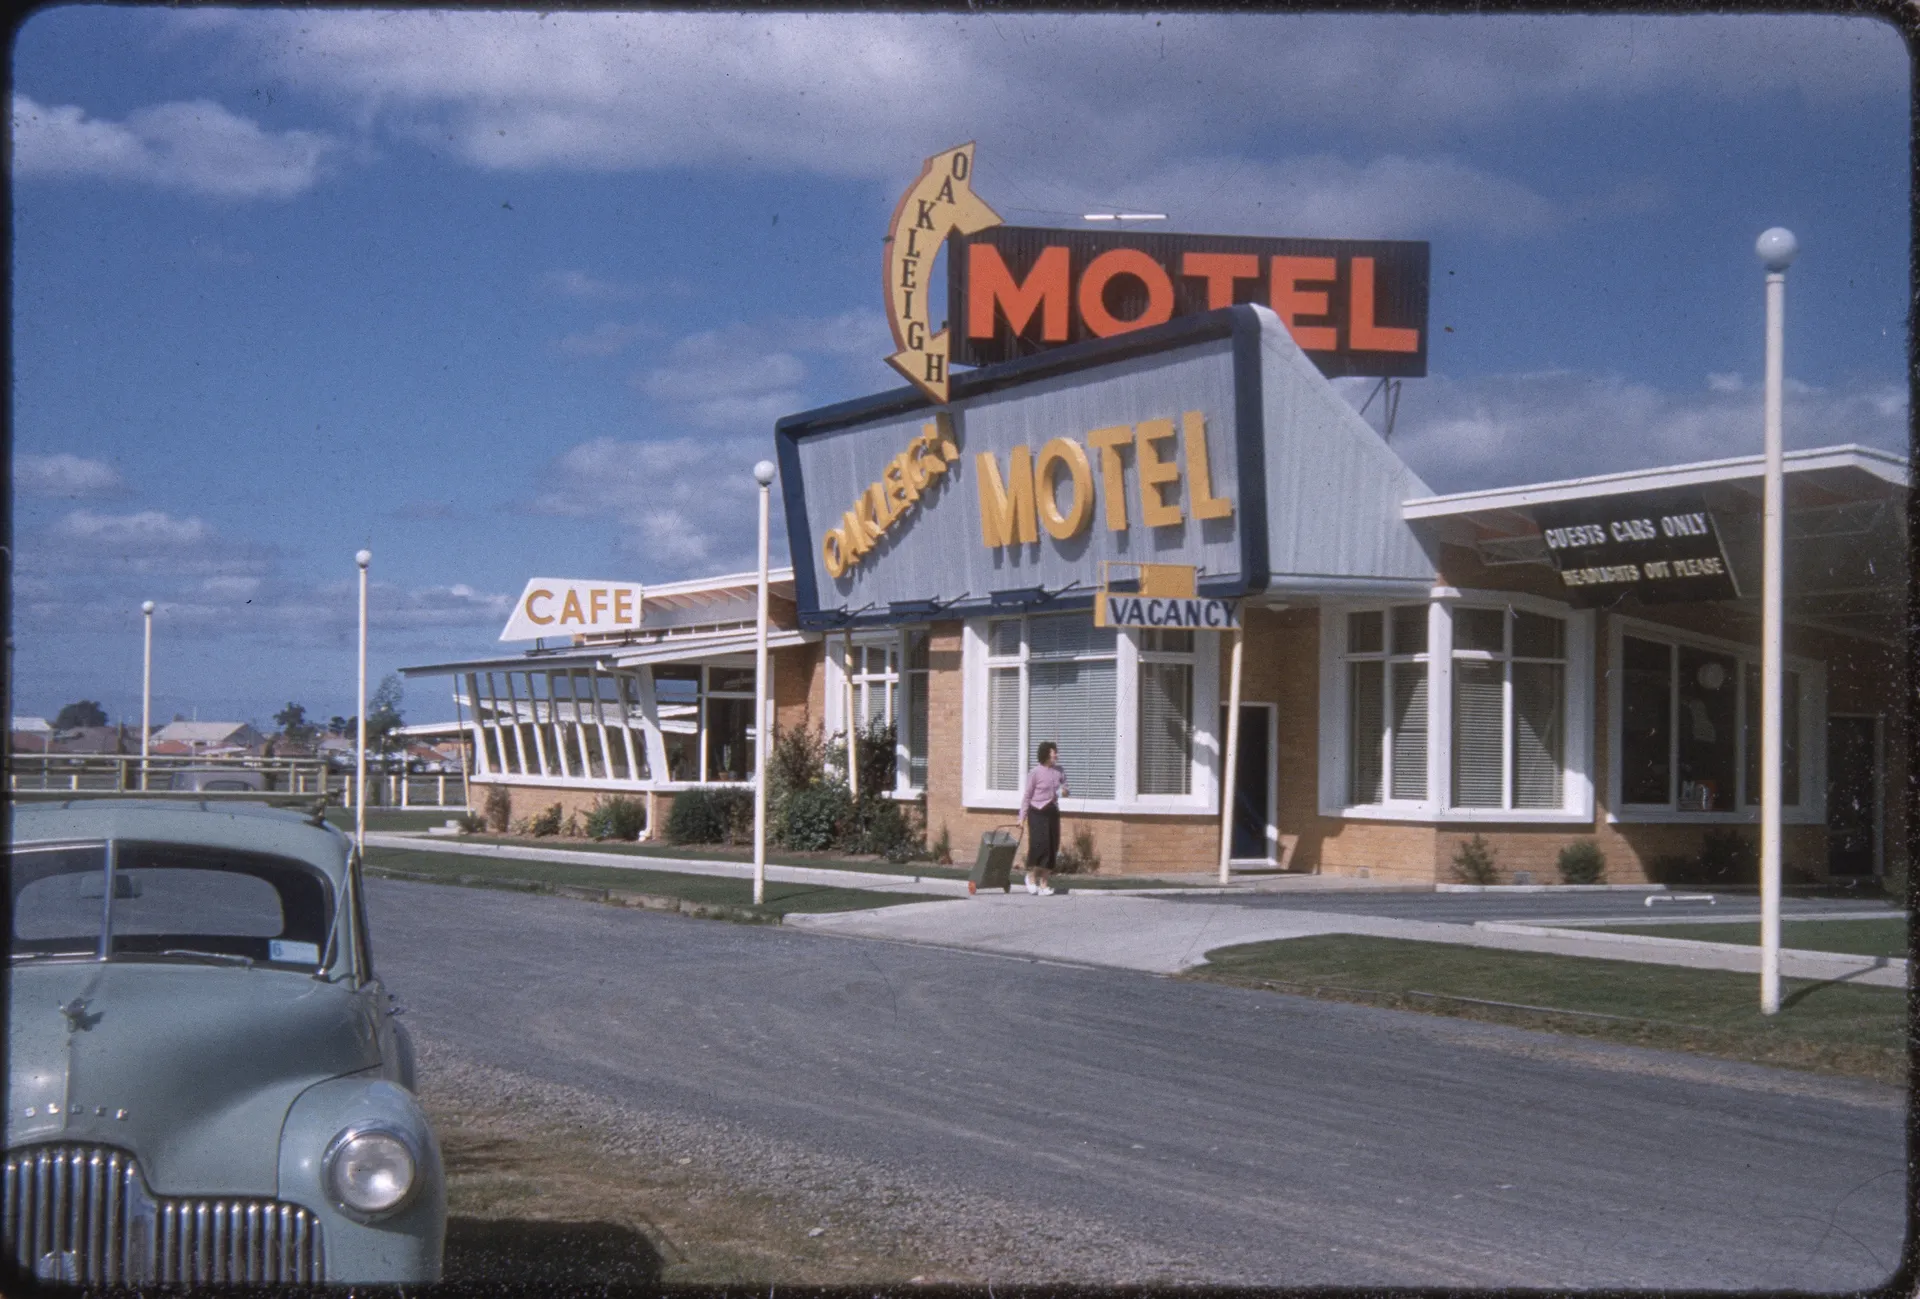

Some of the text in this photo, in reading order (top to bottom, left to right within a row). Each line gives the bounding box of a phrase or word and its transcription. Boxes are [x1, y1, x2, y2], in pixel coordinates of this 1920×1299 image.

[901, 152, 969, 383] OAKLEIGH
[968, 243, 1419, 353] MOTEL
[976, 410, 1233, 548] MOTEL
[1544, 512, 1708, 549] GUESTS CARS ONLY
[1644, 561, 1671, 579] OUT
[1672, 557, 1725, 577] PLEASE
[525, 589, 632, 625] CAFE
[1108, 598, 1239, 627] VACANCY
